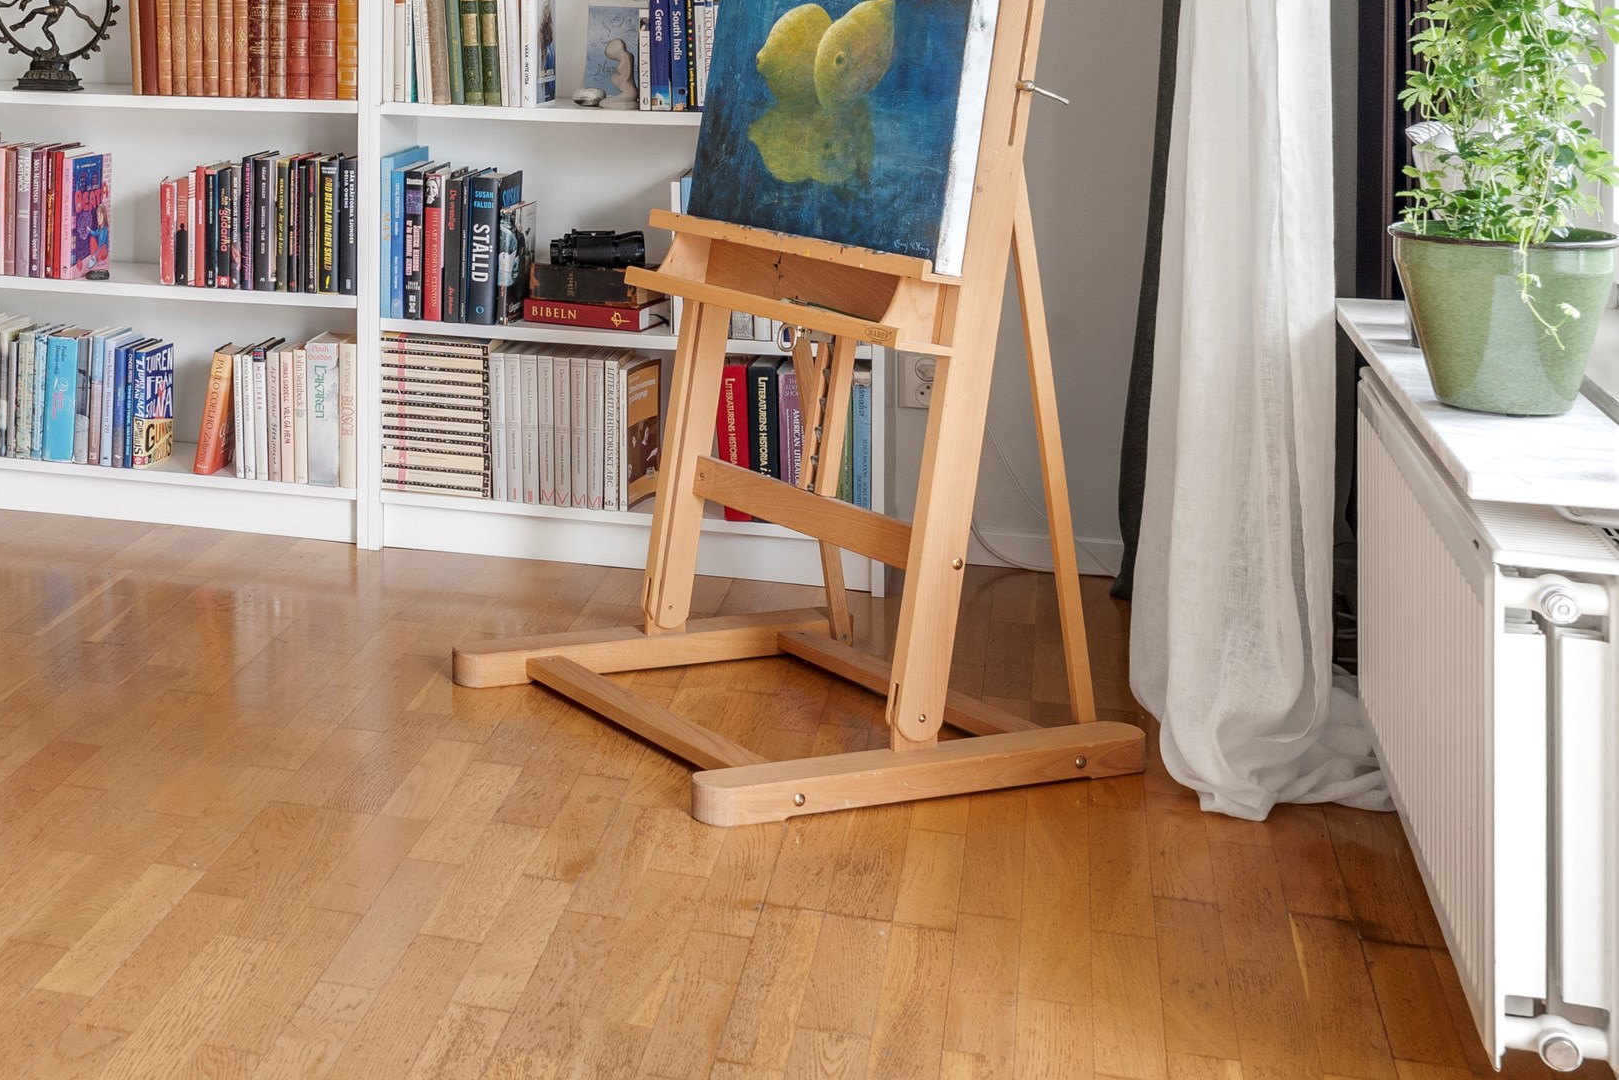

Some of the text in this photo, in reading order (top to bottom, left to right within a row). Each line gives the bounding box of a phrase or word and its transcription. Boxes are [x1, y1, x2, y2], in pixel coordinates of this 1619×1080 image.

[655, 9, 664, 42] Greece
[672, 11, 682, 60] South India
[75, 181, 108, 213] BEATA
[502, 185, 520, 208] SUSAN
[219, 210, 229, 252] gudarna
[324, 177, 332, 270] ORD BETALAR INGEN SKULD
[471, 224, 493, 282] STÄLLD
[531, 306, 577, 319] BIBELN
[868, 329, 889, 339] MABEF
[146, 346, 172, 373] TJUREN
[146, 373, 172, 401] FRÅN
[296, 354, 304, 407] John Steinbeck
[146, 386, 172, 418] SOLNA
[200, 359, 224, 462] PAULO COELHO Zahiren
[341, 395, 354, 436] BLÖSCH
[725, 378, 738, 464] LITTERATURENS HISTORIA
[758, 376, 768, 431] LITTERATURENS
